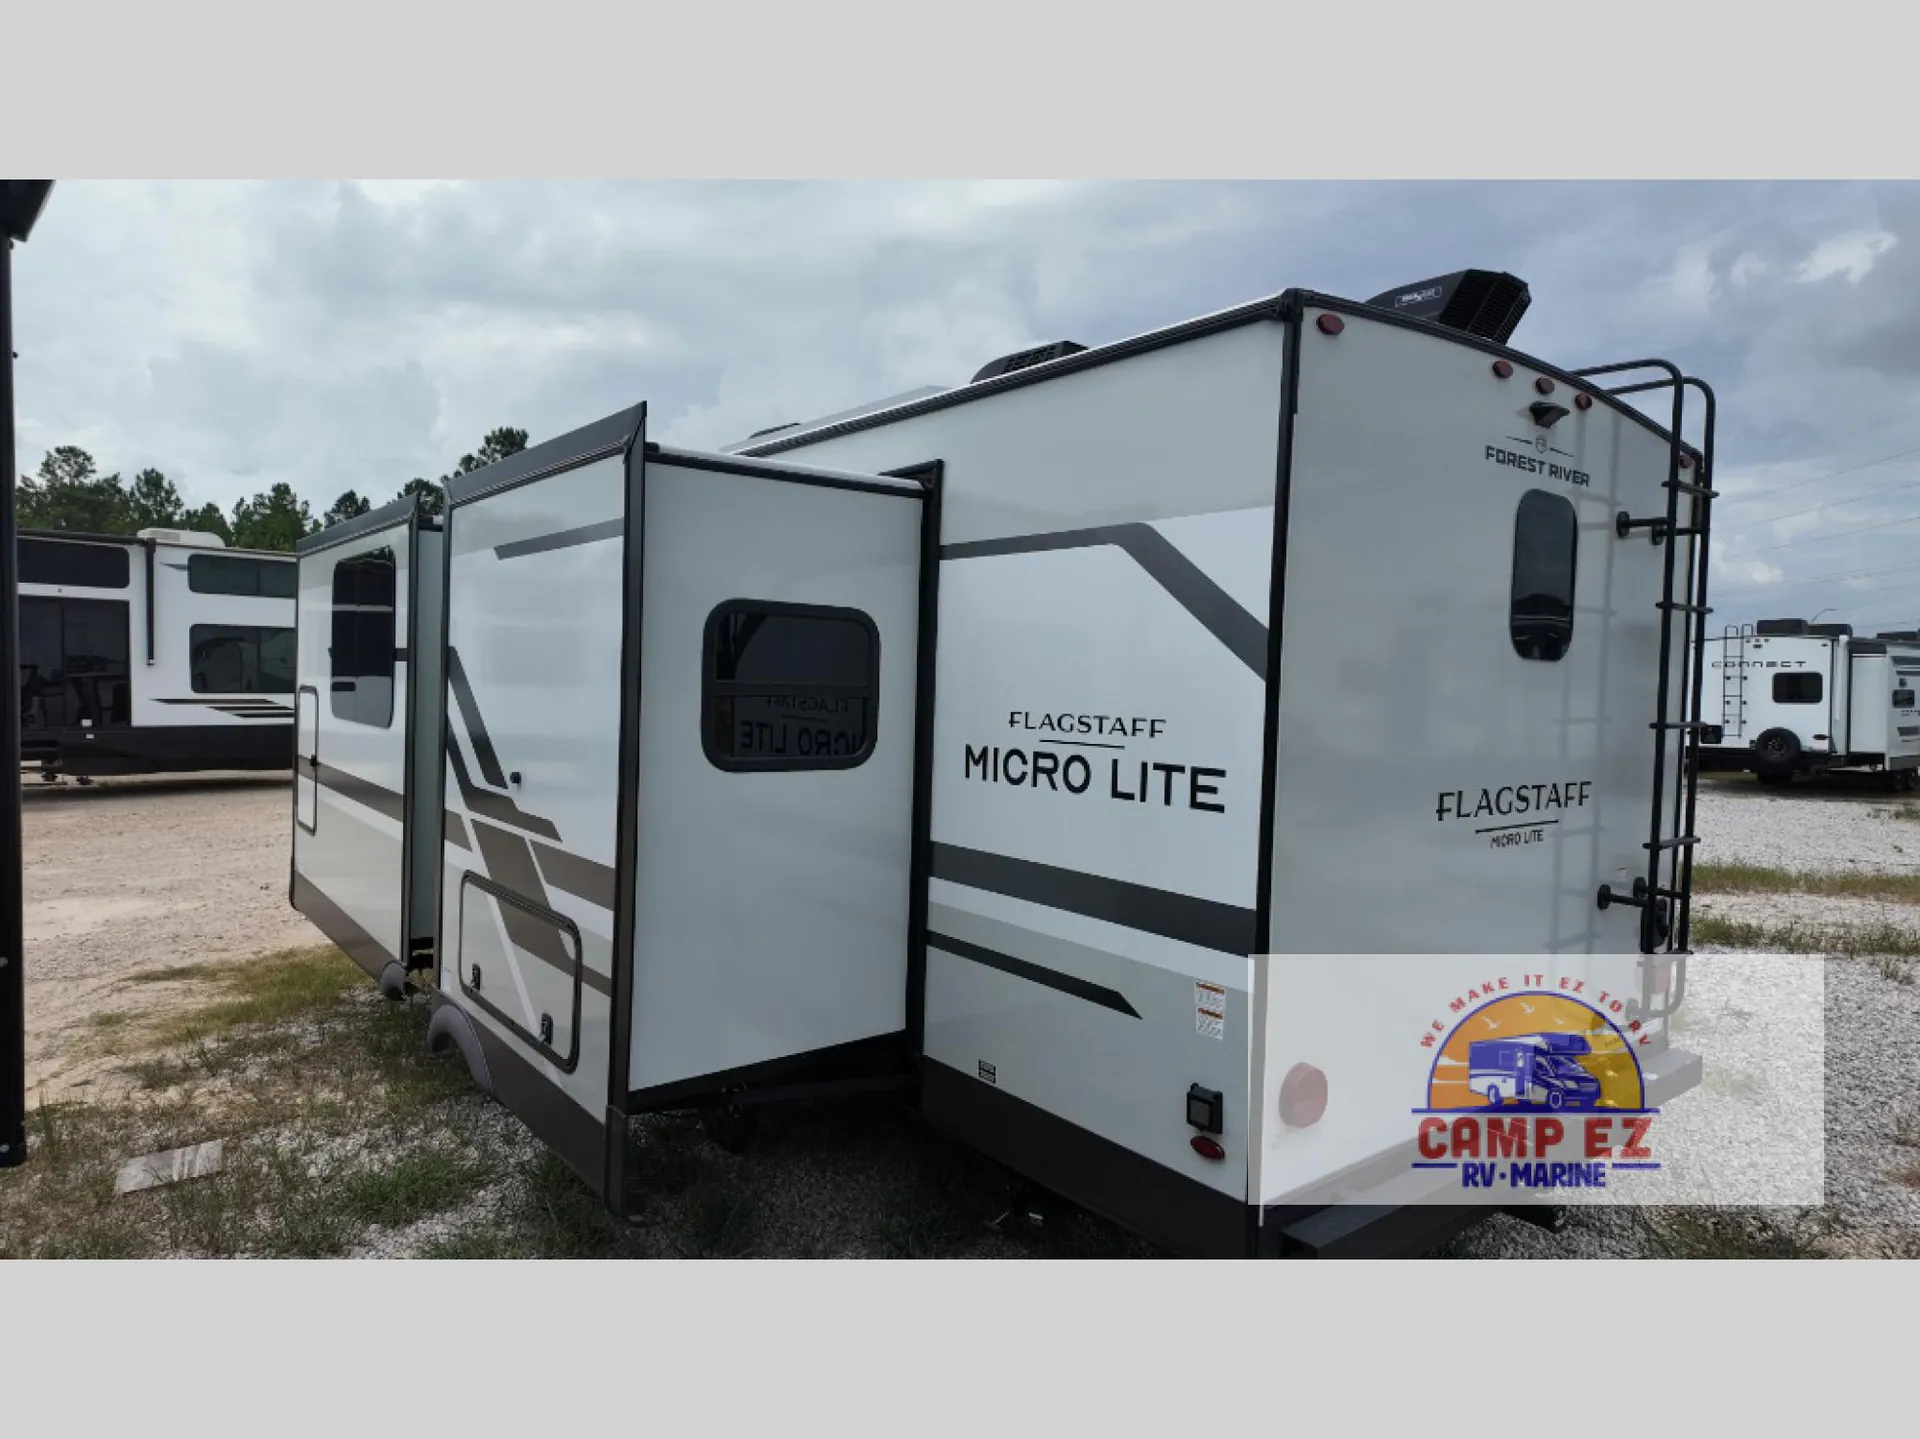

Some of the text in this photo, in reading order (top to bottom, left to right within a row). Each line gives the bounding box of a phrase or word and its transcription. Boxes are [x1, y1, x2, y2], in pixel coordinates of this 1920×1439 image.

[1485, 445, 1590, 487] FOREST RIVER
[1008, 711, 1166, 738] FLAGSTAFF
[964, 743, 1226, 813] MICRO LITE
[1435, 781, 1593, 821] FLAGSTAFF
[1491, 829, 1544, 849] MICRO LITE
